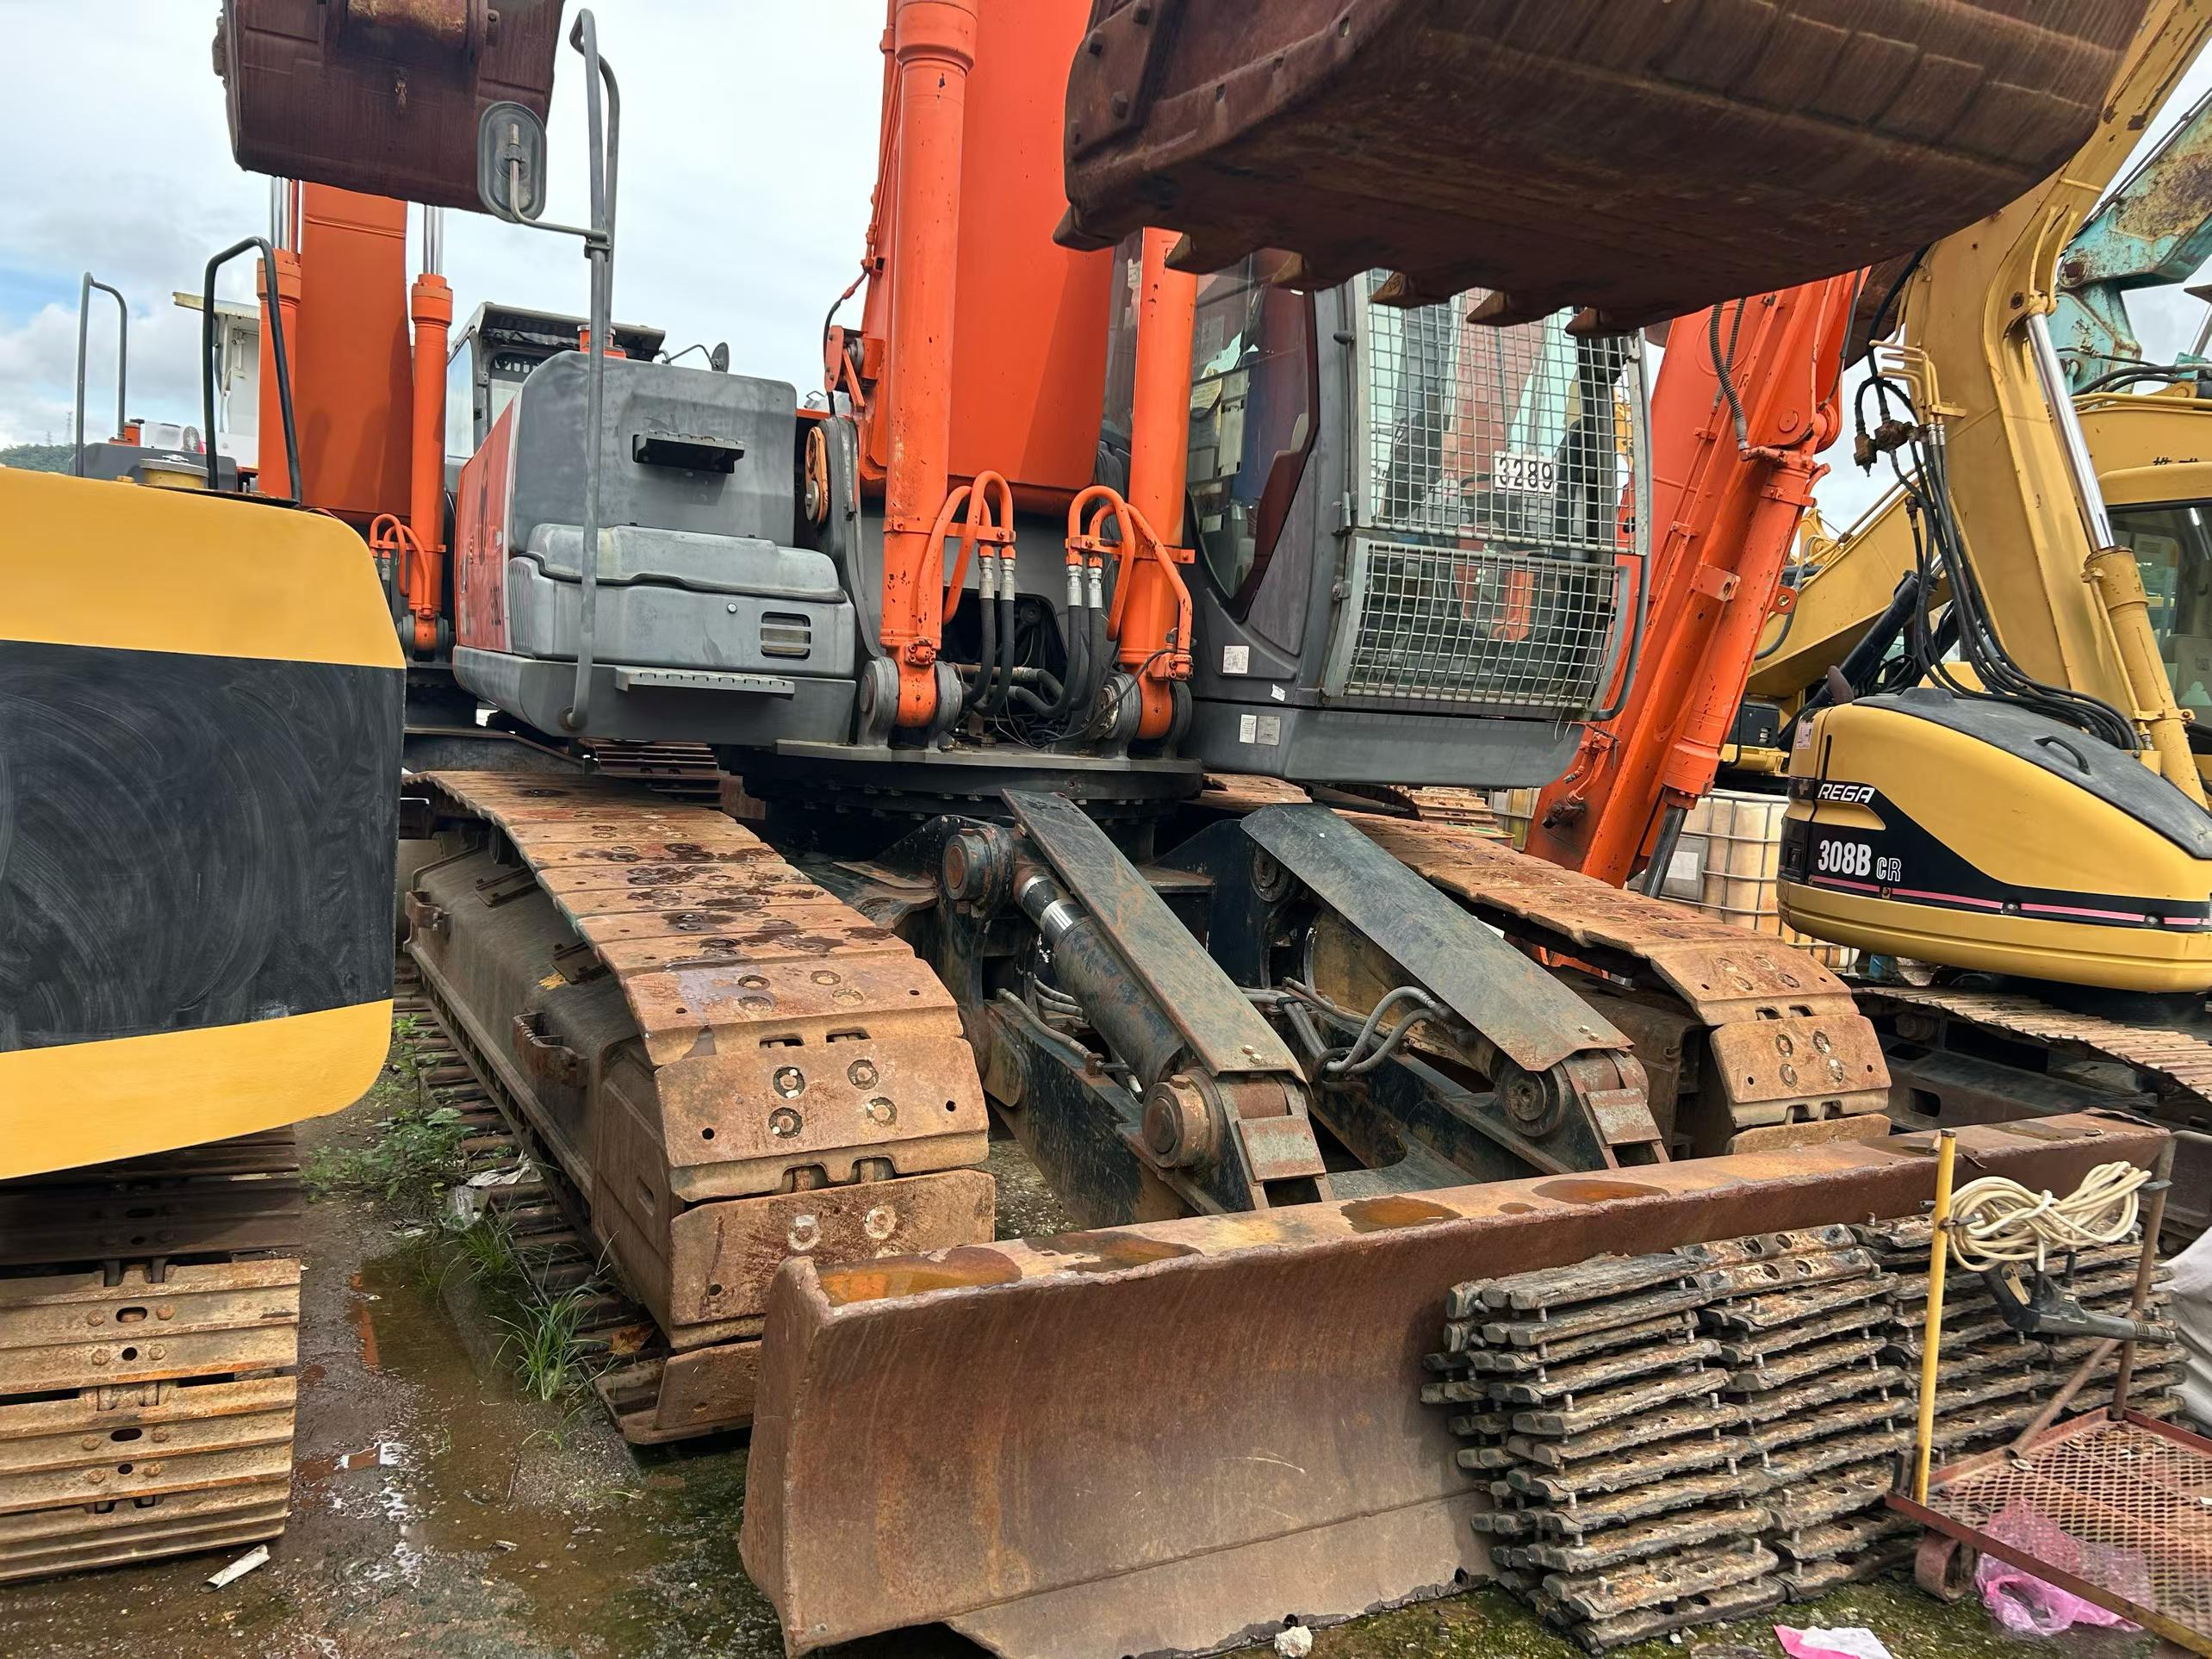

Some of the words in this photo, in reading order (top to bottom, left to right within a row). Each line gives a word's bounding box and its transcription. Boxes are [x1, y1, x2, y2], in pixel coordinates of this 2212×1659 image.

[1499, 457, 1553, 490] 3289
[1817, 783, 1875, 804] REGA
[1817, 839, 1872, 877] 308B
[1876, 856, 1902, 882] CR
